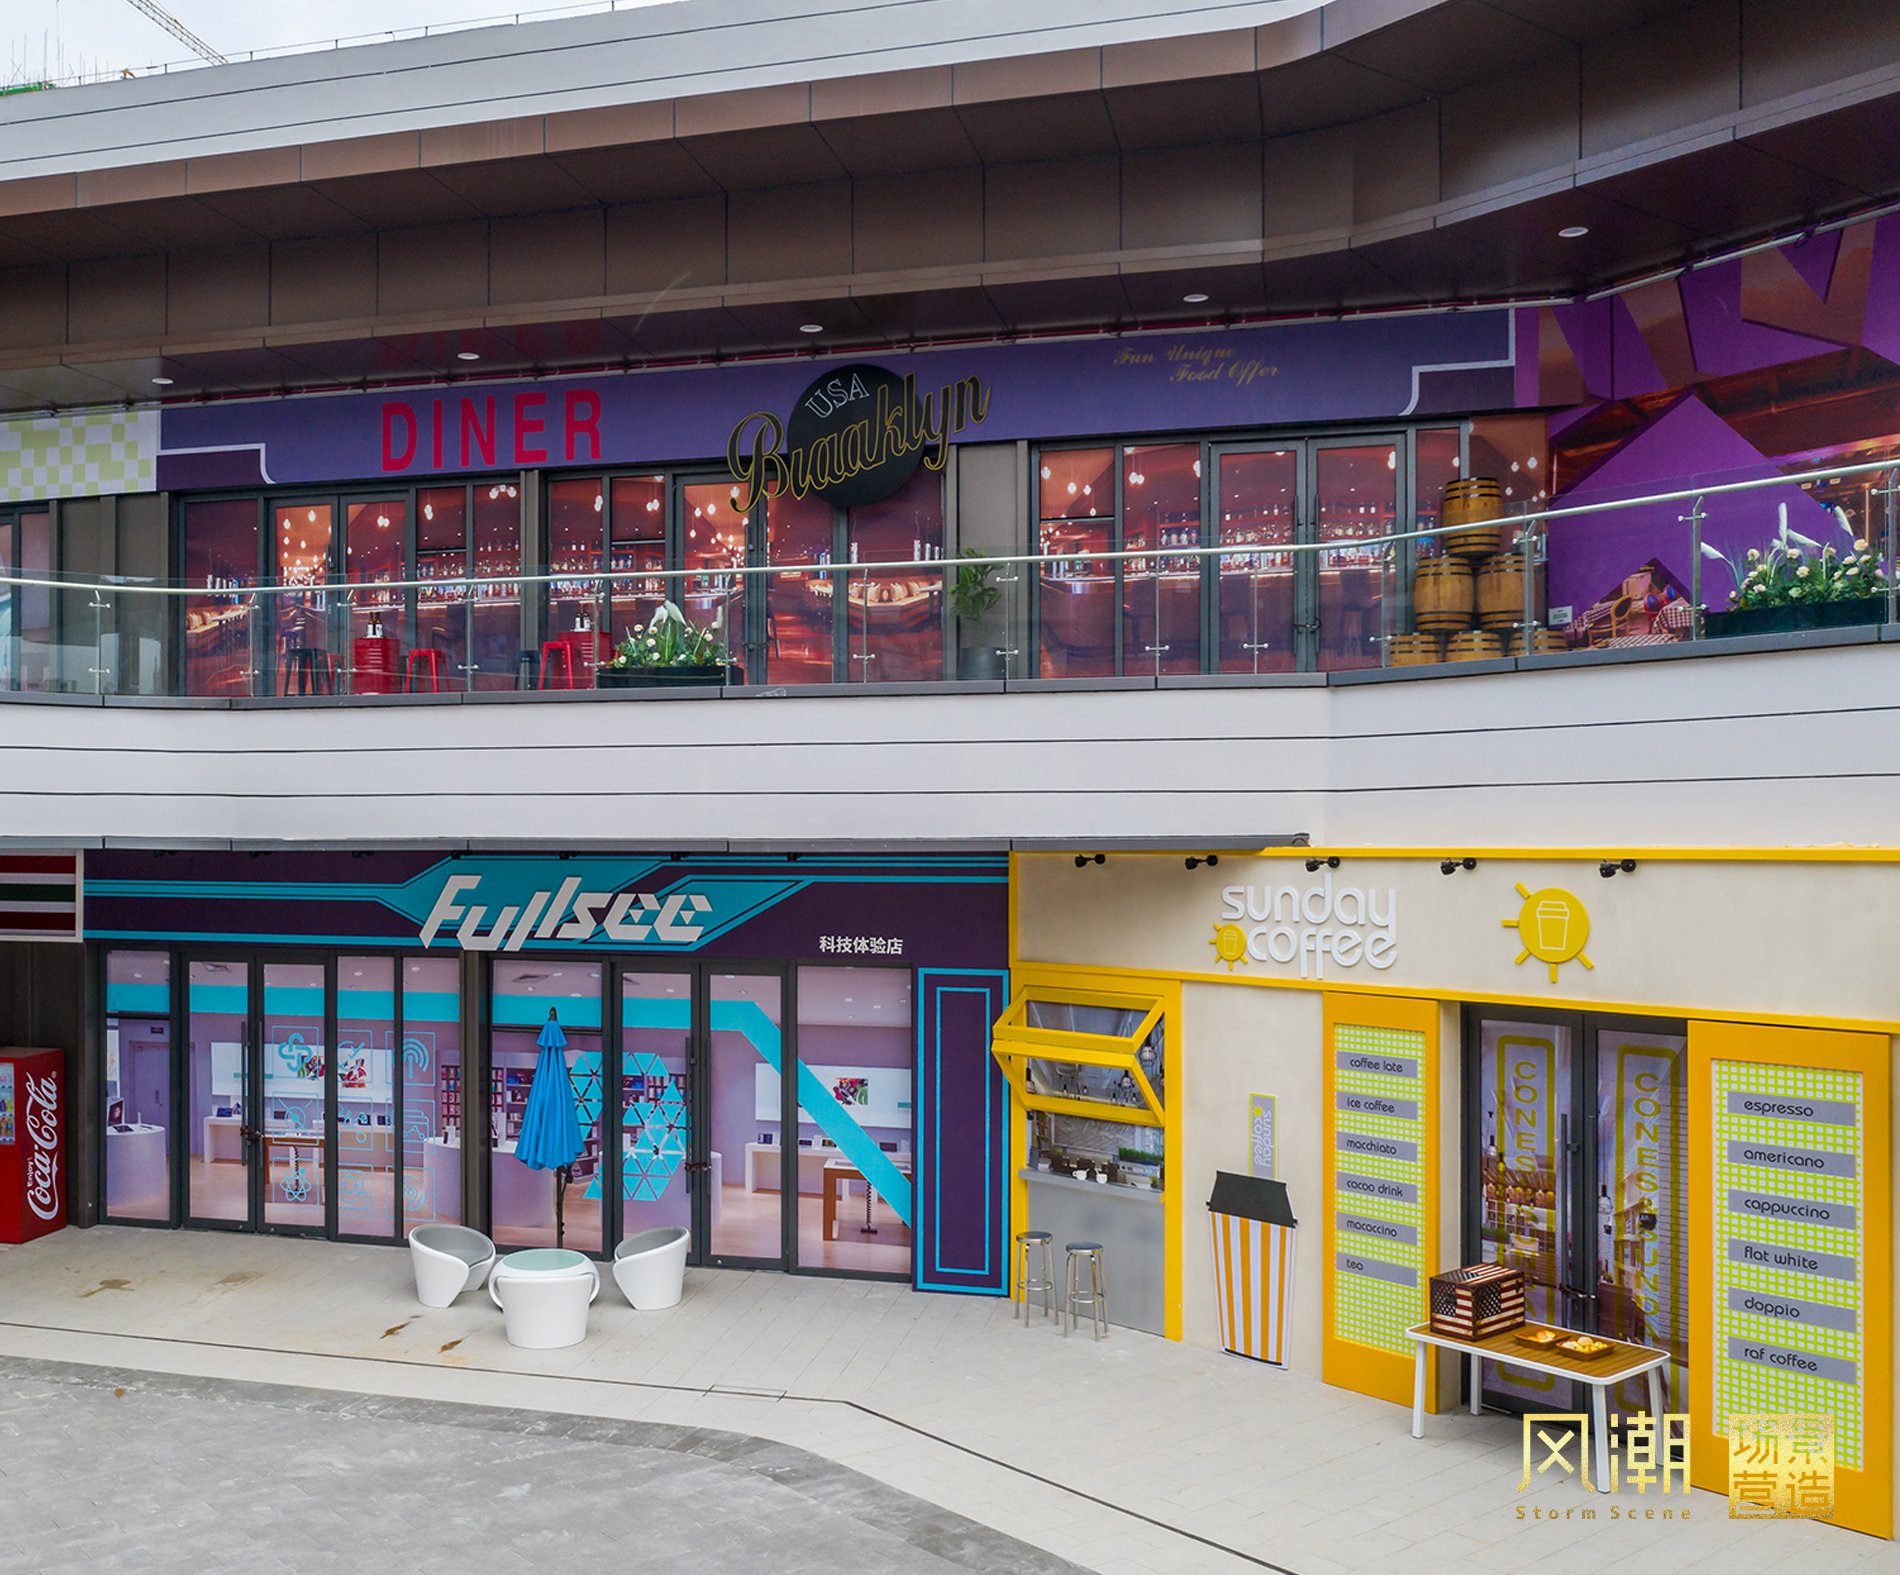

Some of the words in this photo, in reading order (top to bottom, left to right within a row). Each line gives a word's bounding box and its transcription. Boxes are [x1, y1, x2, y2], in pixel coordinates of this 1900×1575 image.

[1114, 347, 1154, 365] Fun
[1169, 363, 1224, 382] Food
[1227, 359, 1278, 386] Offer
[805, 373, 870, 418] USA
[382, 389, 602, 472] DINER
[419, 875, 713, 951] Fullsee
[1222, 872, 1396, 936] sunday
[818, 936, 904, 955] 科技体验店
[1246, 926, 1397, 980] coffee
[1350, 1057, 1380, 1071] coffee
[1383, 1060, 1404, 1073] late
[1347, 1097, 1361, 1109] ice
[1363, 1099, 1395, 1113] coffee
[1514, 1061, 1537, 1173] CONES
[1743, 1100, 1814, 1118] espresso
[1251, 1117, 1264, 1166] coffee
[1262, 1109, 1274, 1167] sunday
[1633, 1072, 1660, 1192] CONES
[1347, 1138, 1397, 1155] macchiato
[1743, 1149, 1825, 1169] americano
[1378, 1182, 1404, 1197] drink
[1743, 1198, 1831, 1220] cappuccino
[1347, 1258, 1364, 1271] tea
[1743, 1246, 1769, 1262] flat
[1774, 1248, 1819, 1271] white
[1743, 1297, 1801, 1318] doppio
[1743, 1347, 1766, 1363] raf
[1769, 1351, 1818, 1373] coffee
